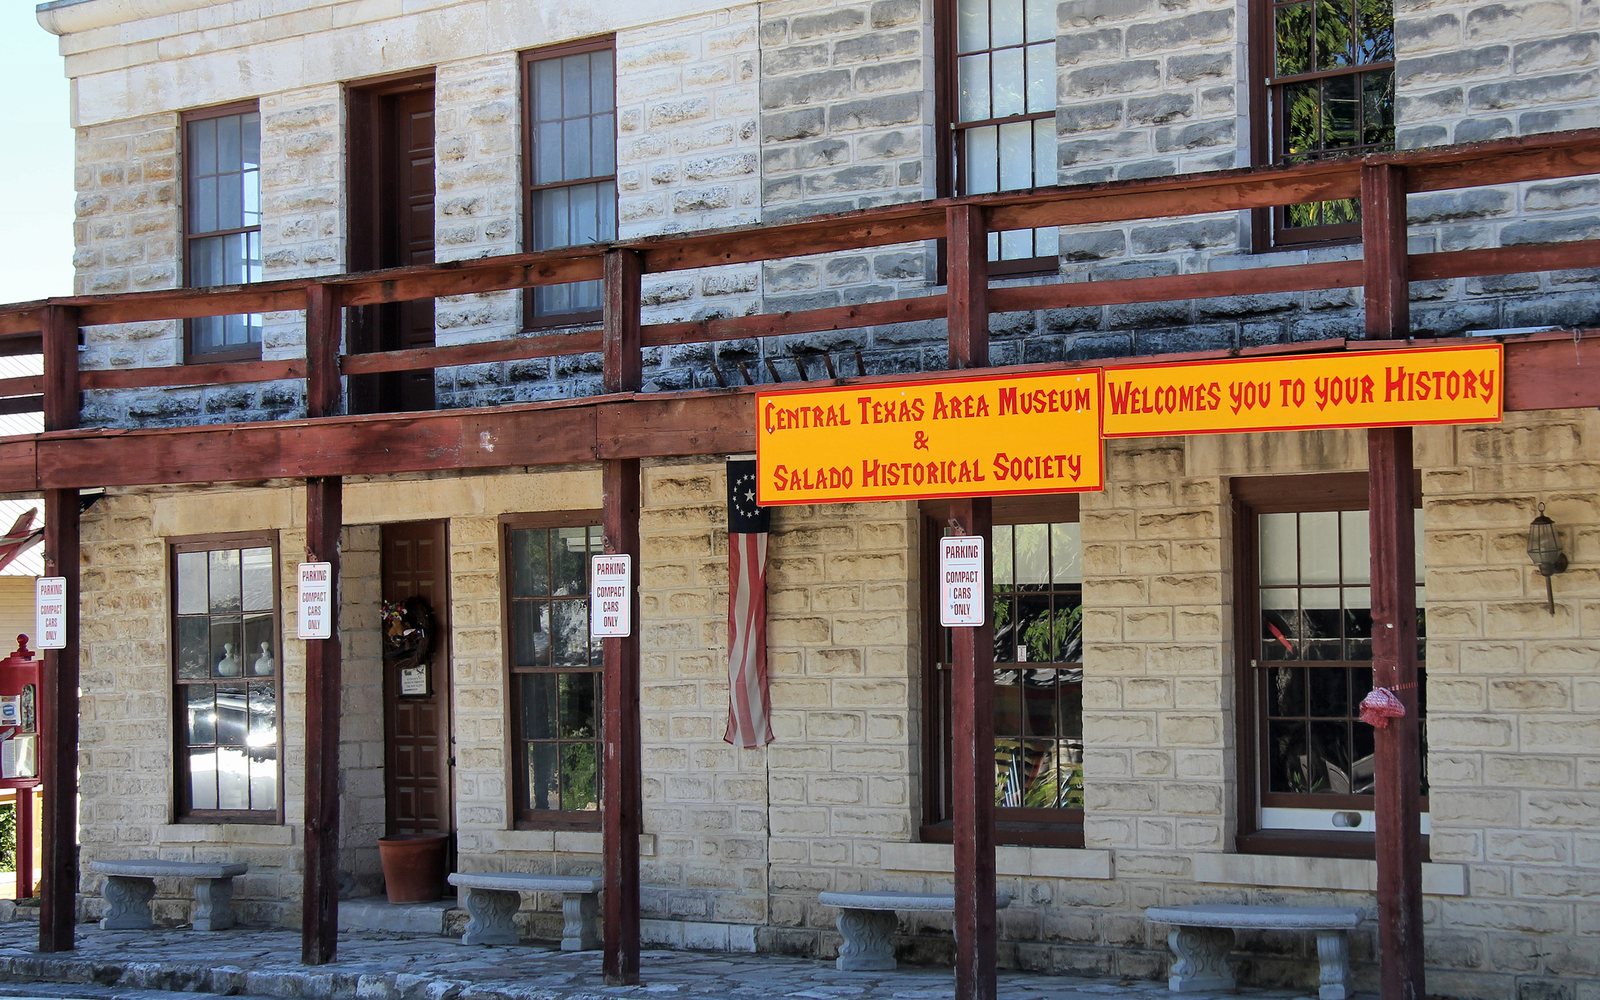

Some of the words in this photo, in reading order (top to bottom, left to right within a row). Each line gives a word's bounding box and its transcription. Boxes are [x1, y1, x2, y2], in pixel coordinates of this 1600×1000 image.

[1108, 381, 1220, 415] WELCOMES
[1229, 380, 1270, 415] YOU
[1280, 378, 1305, 408] TO
[1314, 375, 1374, 411] YOUR
[1384, 367, 1494, 404] HISTORY
[765, 403, 850, 434] CENTRAL
[858, 397, 924, 425] TEXAS
[933, 392, 989, 420] AREA
[999, 387, 1091, 416] MUSEUM
[914, 431, 929, 450] &
[774, 465, 852, 491] SALADO
[862, 459, 985, 488] HISTORICAL
[993, 453, 1081, 482] SOCIETY
[946, 545, 978, 559] PARKING
[597, 563, 625, 575] PARKING
[302, 570, 327, 581] PARKING
[946, 571, 978, 583] COMPACT
[40, 584, 62, 595] PARKING
[597, 586, 625, 598] COMPACT
[953, 587, 971, 599] CARS
[302, 592, 327, 602] COMPACT
[40, 604, 62, 615] COMPACT
[308, 606, 321, 616] CARS
[603, 601, 619, 612] CARS
[954, 603, 970, 616] ONLY
[45, 618, 58, 627] CARS
[308, 619, 320, 630] ONLY
[603, 616, 618, 627] ONLY
[46, 630, 57, 640] ONLY
